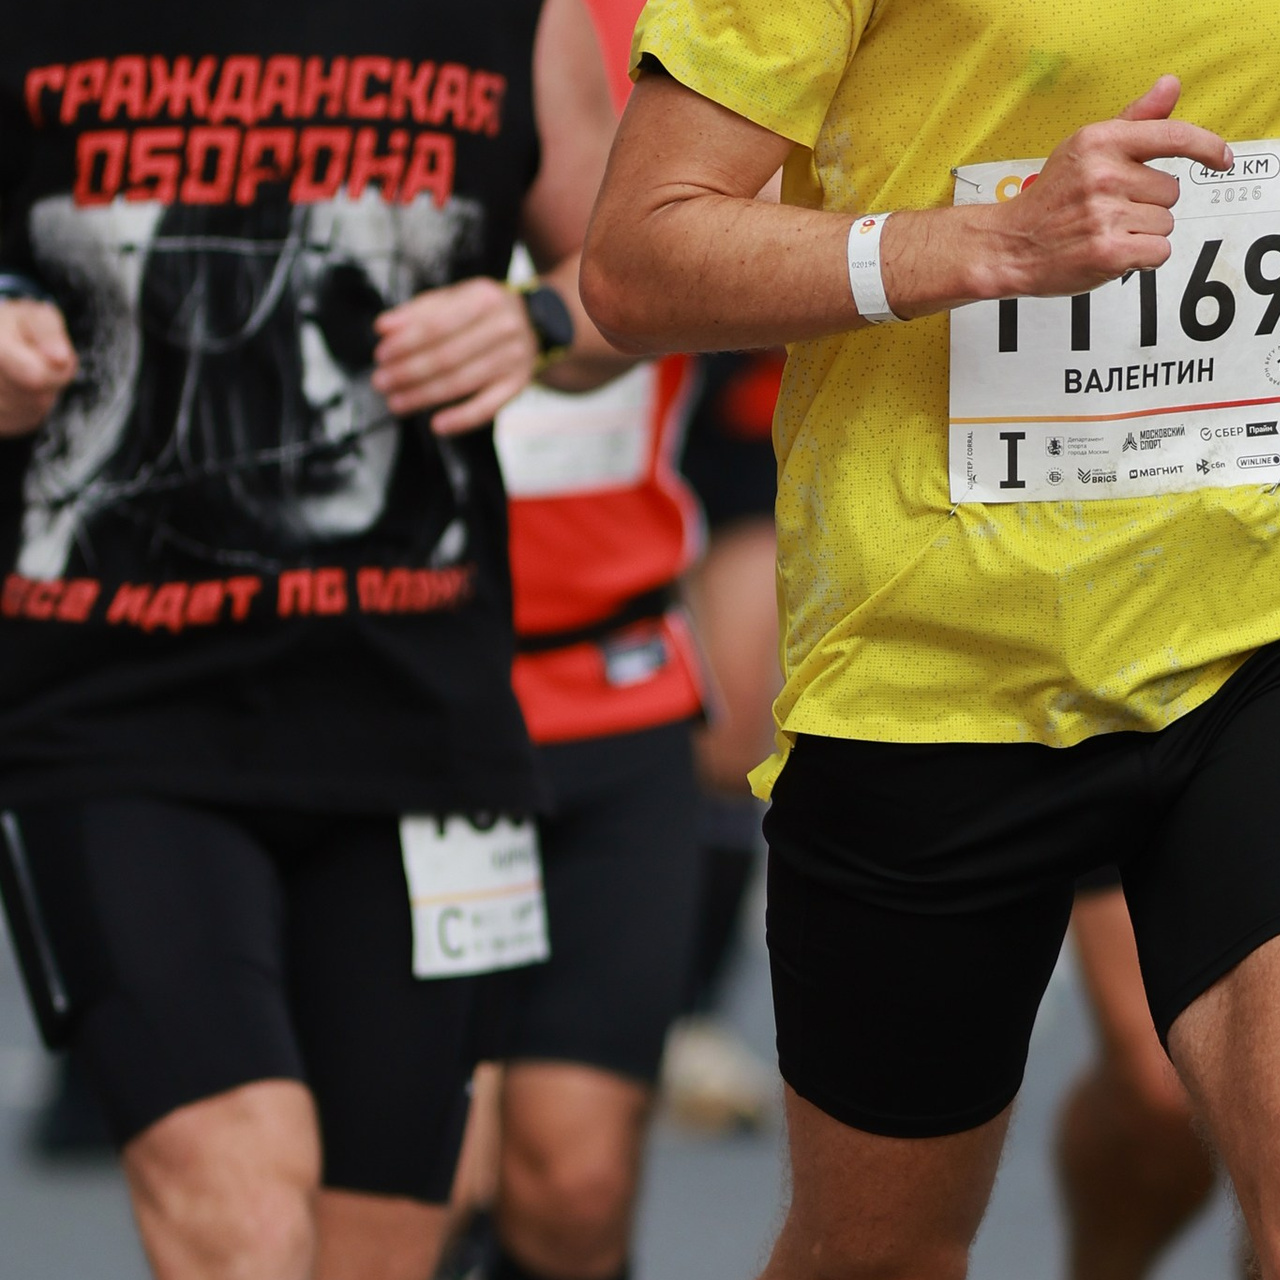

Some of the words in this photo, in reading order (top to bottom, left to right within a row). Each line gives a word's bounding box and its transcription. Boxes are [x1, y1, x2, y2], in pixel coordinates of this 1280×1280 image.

[24, 54, 506, 136] ГРАЖДАНСКАЯ
[72, 125, 457, 210] ОБОРОНА
[1210, 185, 1262, 205] 2026
[851, 259, 877, 270] 020196
[1063, 357, 1215, 395] ВАЛЕНТИН
[1140, 424, 1186, 439] МОСКОВСКИЙ
[1214, 426, 1244, 438] СБЕР
[1249, 424, 1274, 434] Прайм
[966, 431, 974, 456] CORRAL
[1140, 439, 1162, 451] СПОРТ
[1240, 456, 1272, 467] WINLINE
[1139, 464, 1185, 478] магнит
[1092, 474, 1118, 484] BRICS
